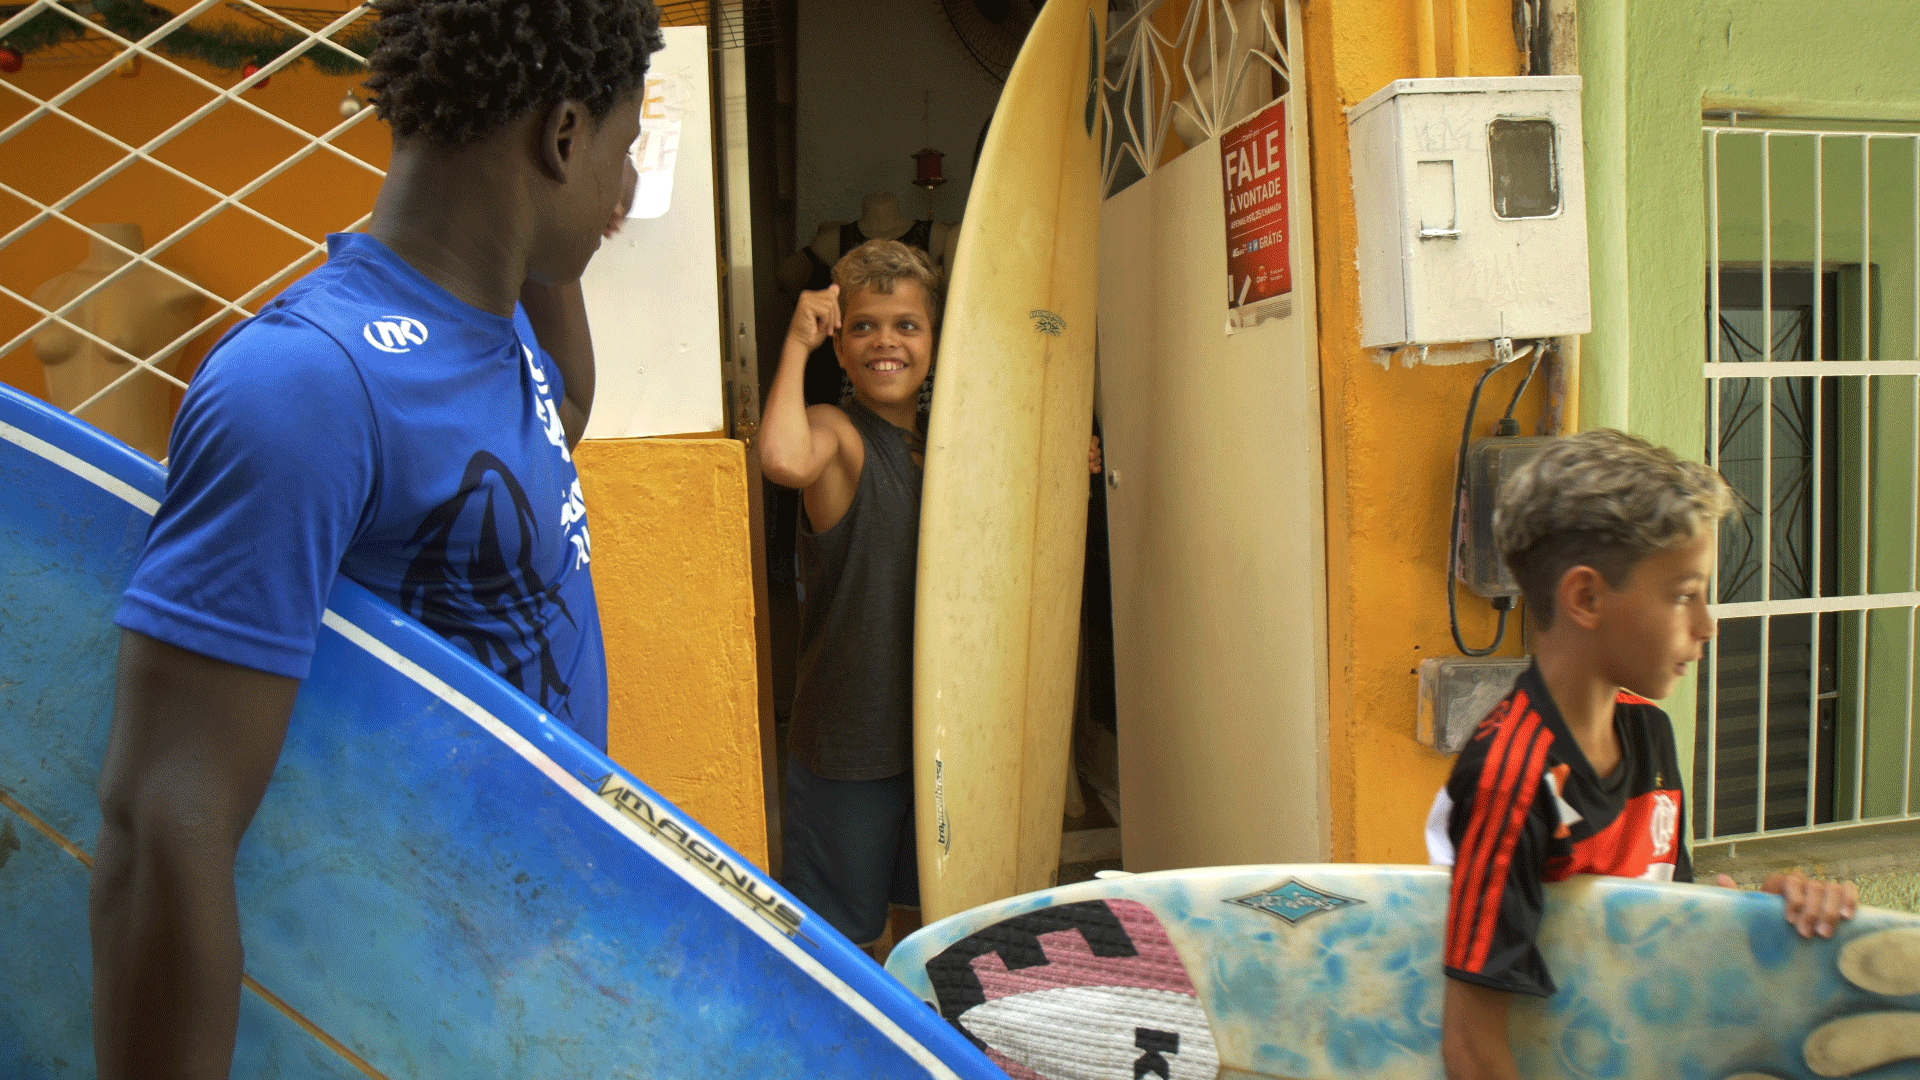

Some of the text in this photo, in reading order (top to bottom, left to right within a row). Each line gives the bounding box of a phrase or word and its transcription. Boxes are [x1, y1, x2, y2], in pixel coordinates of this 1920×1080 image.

[1226, 129, 1280, 191] FALE
[1229, 176, 1282, 215] À VONTADE
[1259, 230, 1283, 249] GRÁTIS
[618, 787, 804, 929] MAGNUS
